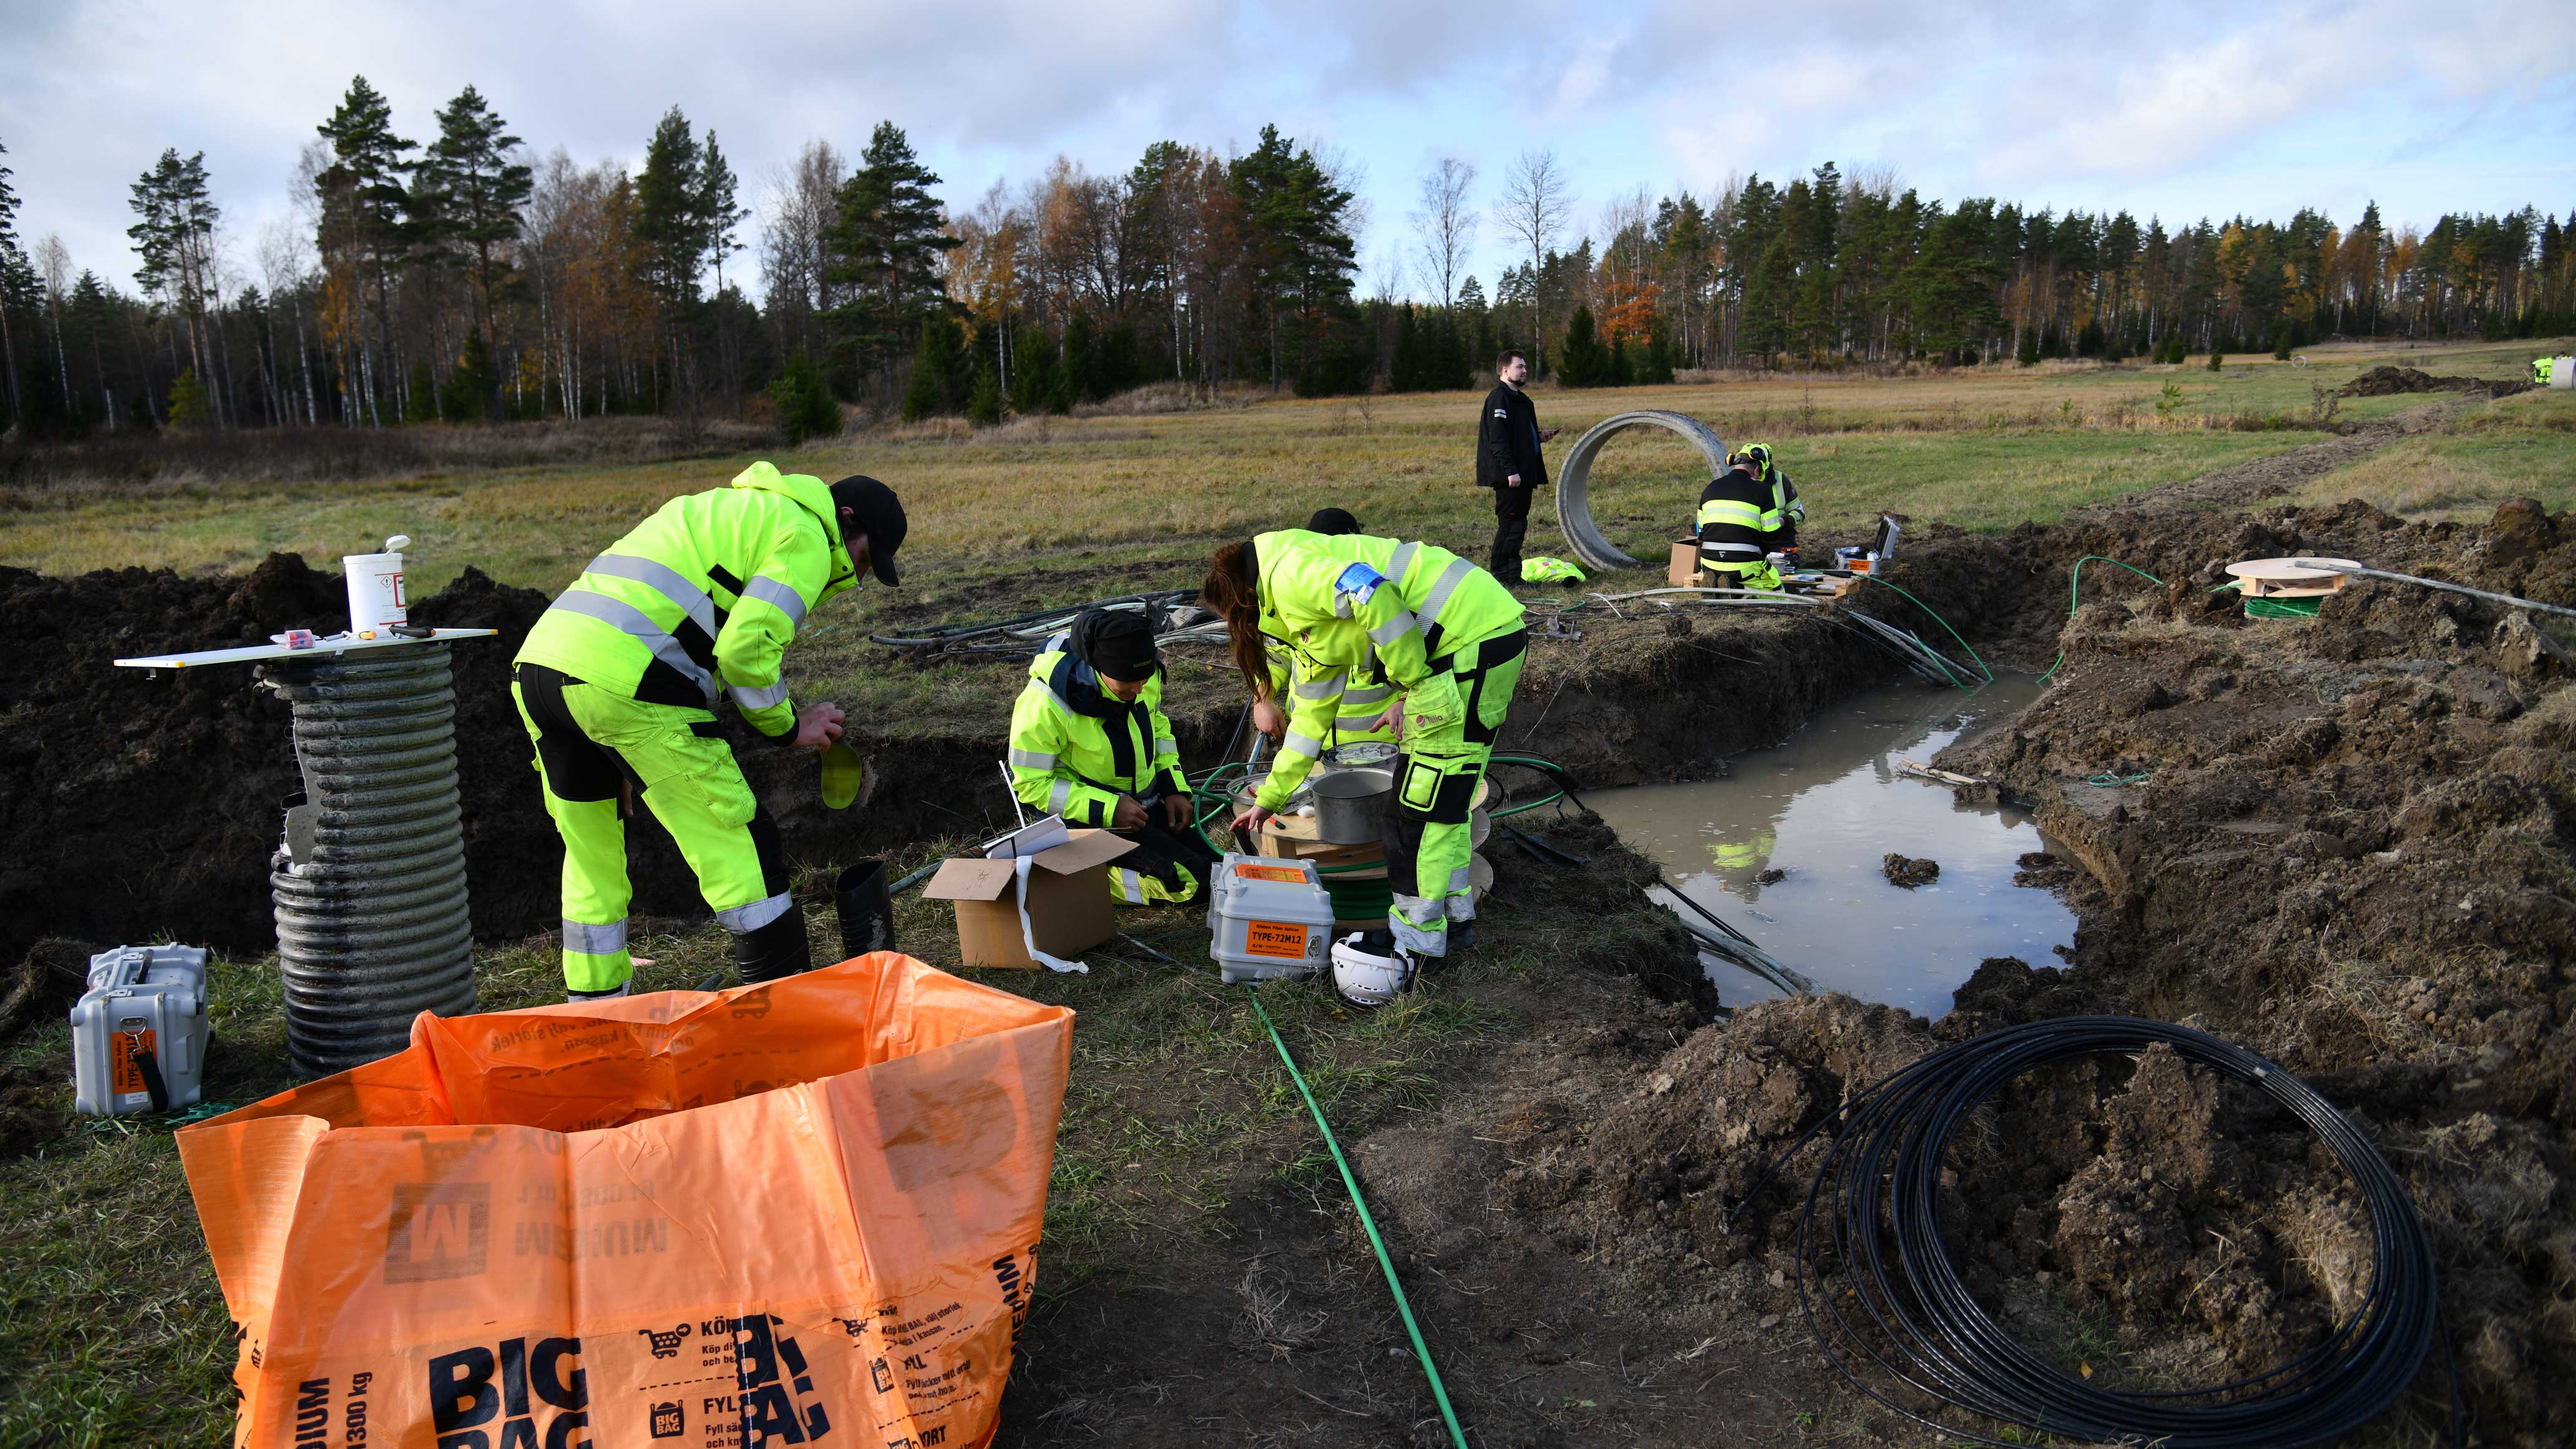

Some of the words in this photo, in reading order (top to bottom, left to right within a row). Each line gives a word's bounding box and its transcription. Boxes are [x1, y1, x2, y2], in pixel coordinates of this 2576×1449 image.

[1252, 932, 1301, 944] TYPE-72M12
[702, 1344, 721, 1354] Köp
[703, 1358, 720, 1367] och
[348, 1372, 373, 1397] kg
[429, 1337, 588, 1435] BIG
[655, 1412, 680, 1426] BIG
[656, 1423, 680, 1435] BAG
[706, 1424, 723, 1435] Fyll
[706, 1440, 724, 1448] och
